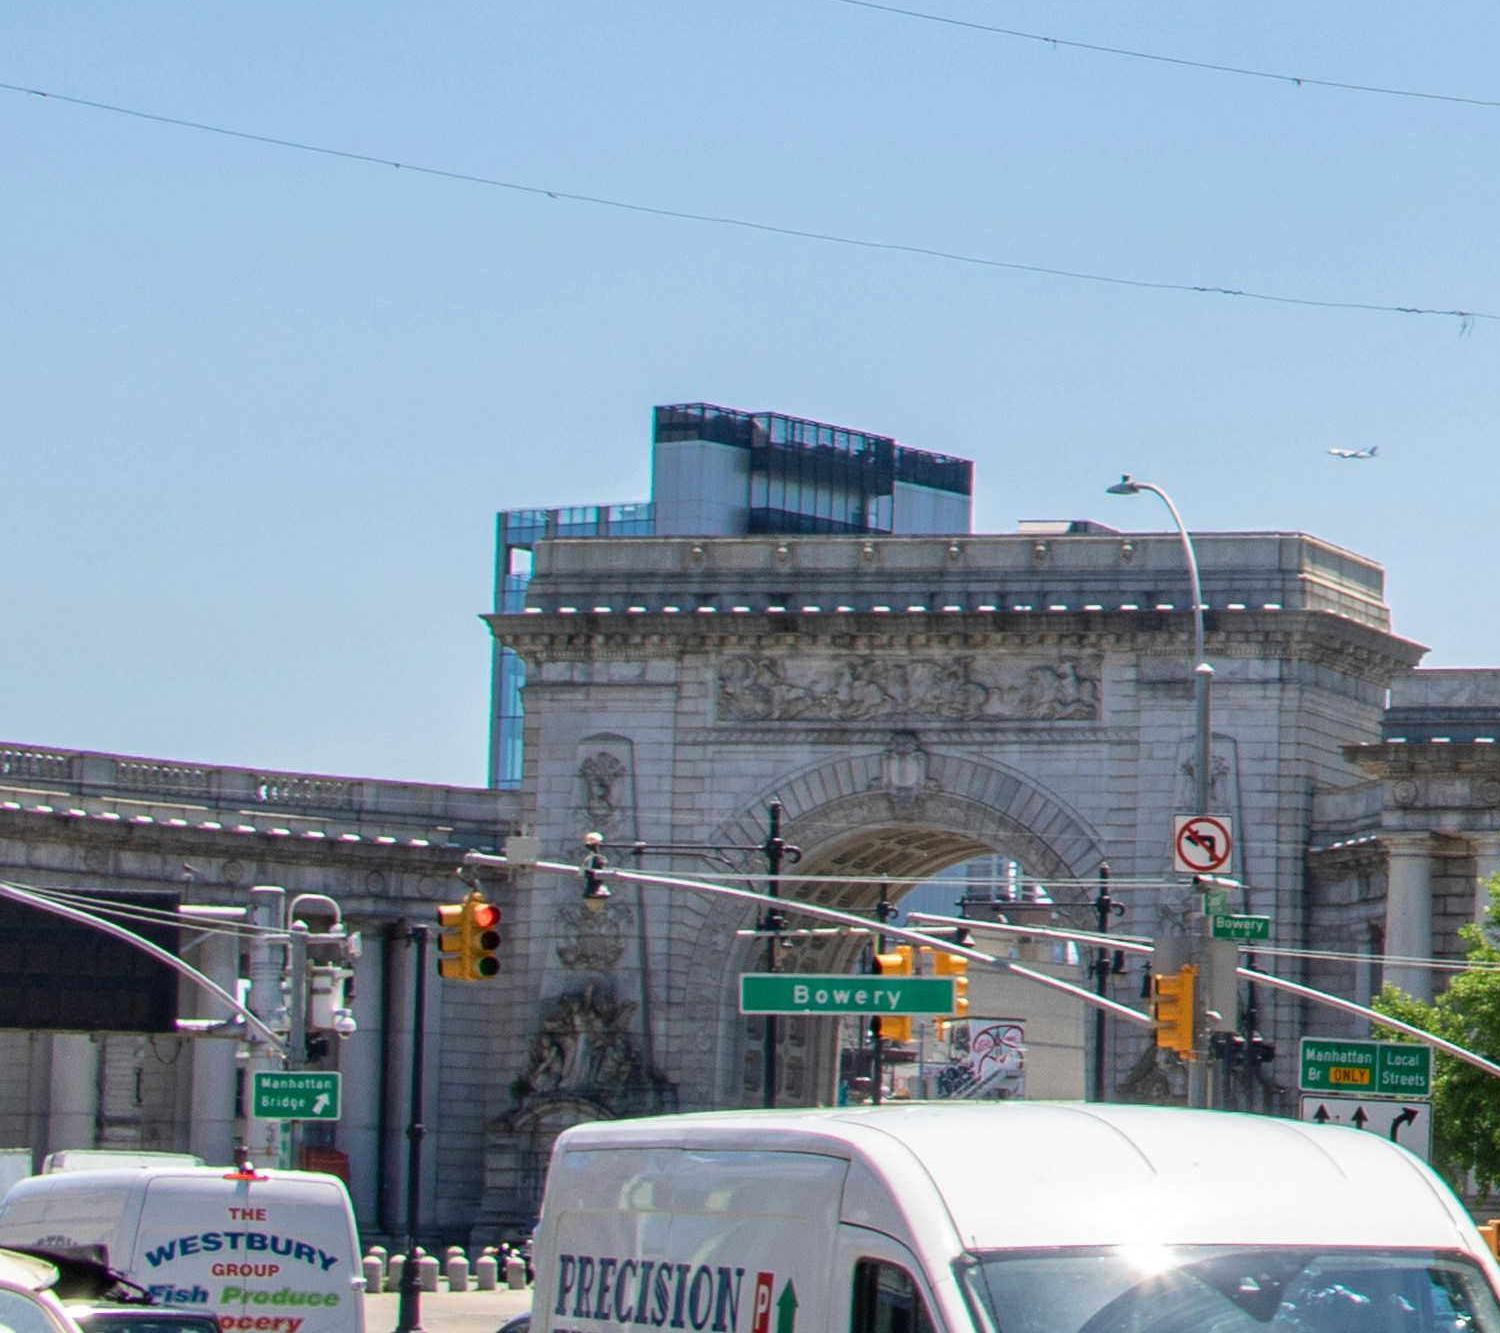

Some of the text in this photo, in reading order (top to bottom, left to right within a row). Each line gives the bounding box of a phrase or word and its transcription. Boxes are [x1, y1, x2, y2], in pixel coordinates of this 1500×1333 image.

[1216, 916, 1265, 933] Bowery
[792, 984, 902, 1010] Bowery
[1306, 1047, 1373, 1064] Manhattan
[1386, 1052, 1419, 1066] Local
[1307, 1067, 1367, 1083] Br ONLY
[1382, 1071, 1426, 1087] Streets
[260, 1077, 333, 1090] Manhattan
[260, 1095, 306, 1111] Bridge
[228, 1207, 267, 1222] THE
[145, 1232, 339, 1272] WESTBURY
[211, 1263, 280, 1277] GROUP
[148, 1285, 340, 1307] Fish Produce
[555, 1253, 746, 1333] PRECISION
[218, 1314, 306, 1333] ocery
